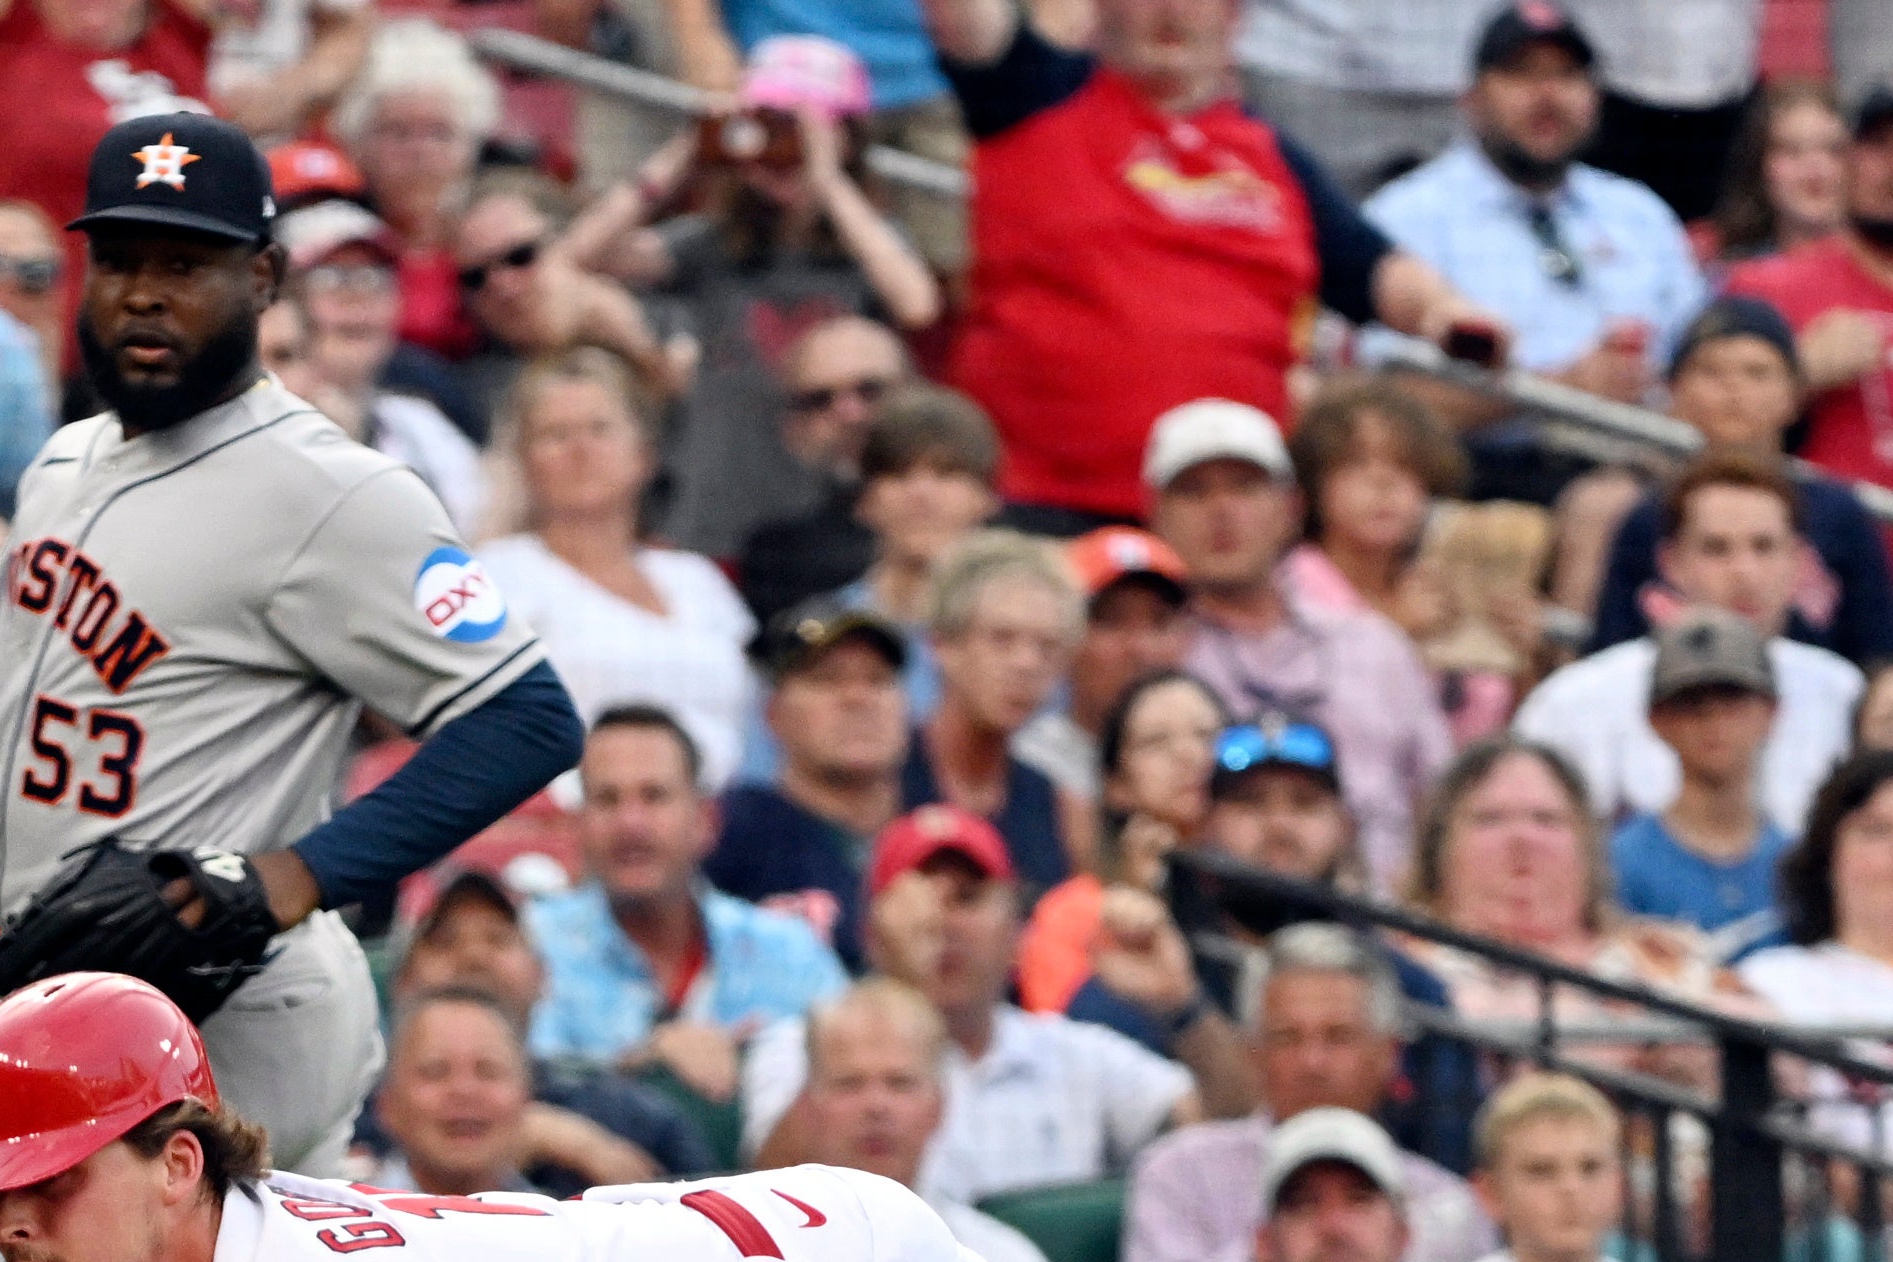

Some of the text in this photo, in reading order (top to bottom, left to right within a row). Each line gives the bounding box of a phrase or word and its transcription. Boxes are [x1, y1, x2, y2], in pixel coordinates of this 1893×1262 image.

[9, 537, 172, 695] STON
[21, 693, 146, 818] 53
[268, 1186, 406, 1254] GO
